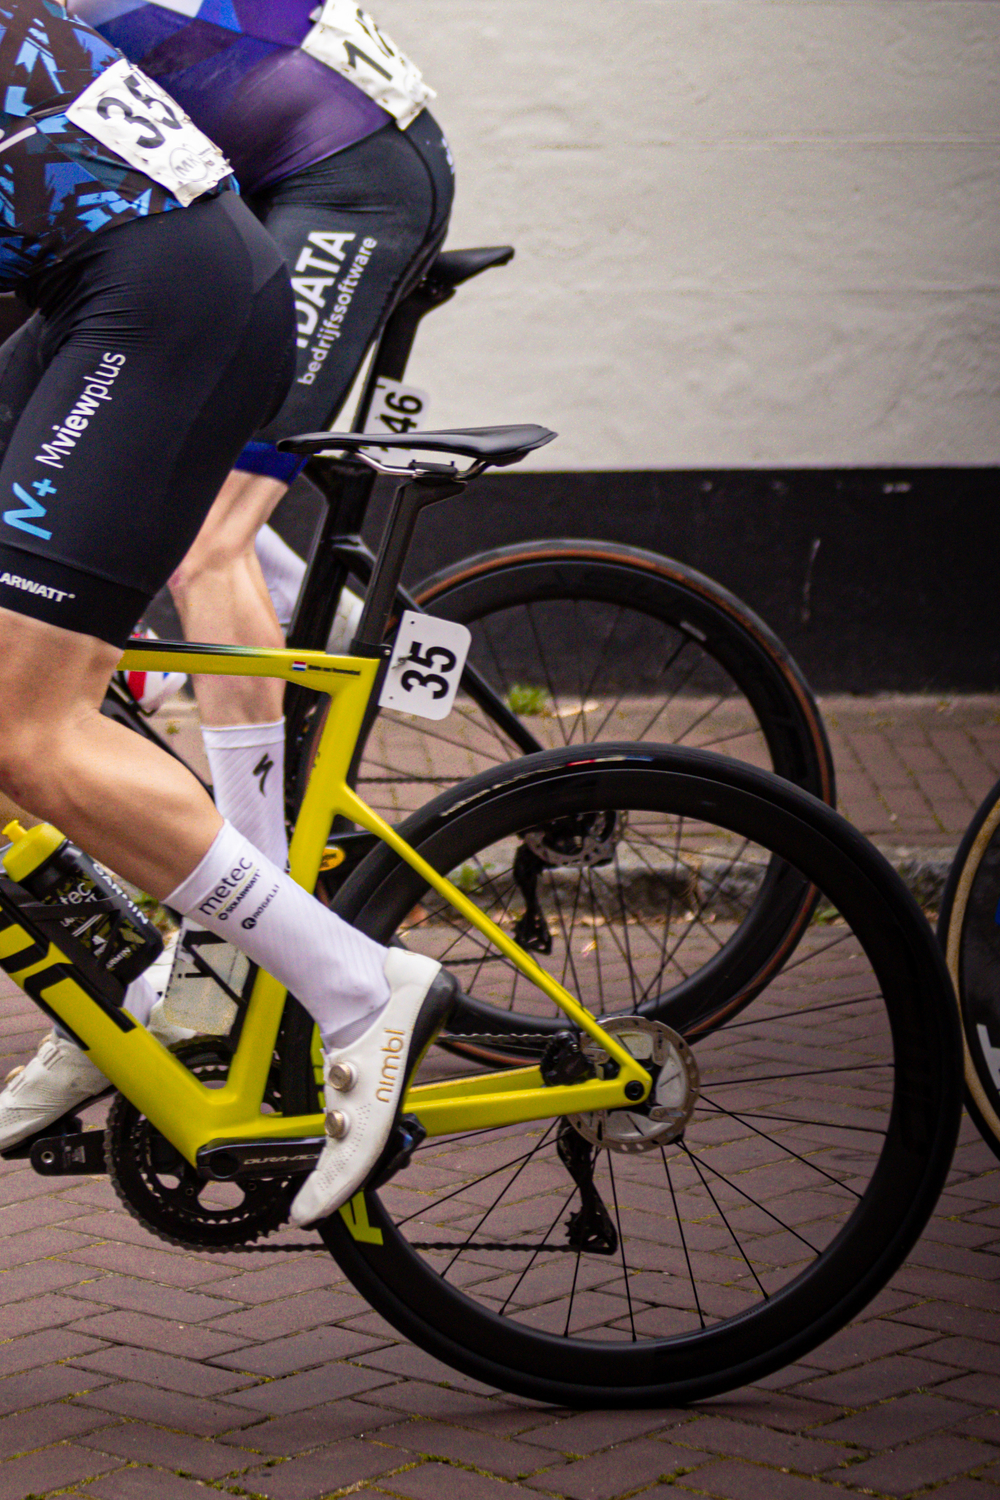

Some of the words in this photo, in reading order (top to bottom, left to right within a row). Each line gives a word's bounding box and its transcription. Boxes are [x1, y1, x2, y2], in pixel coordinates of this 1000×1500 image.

[96, 74, 183, 149] 35
[297, 235, 378, 386] bedrijfssoftware
[33, 351, 127, 469] Mviewplus
[400, 640, 457, 700] 35
[198, 856, 254, 916] metec
[375, 1027, 406, 1104] nimbl
